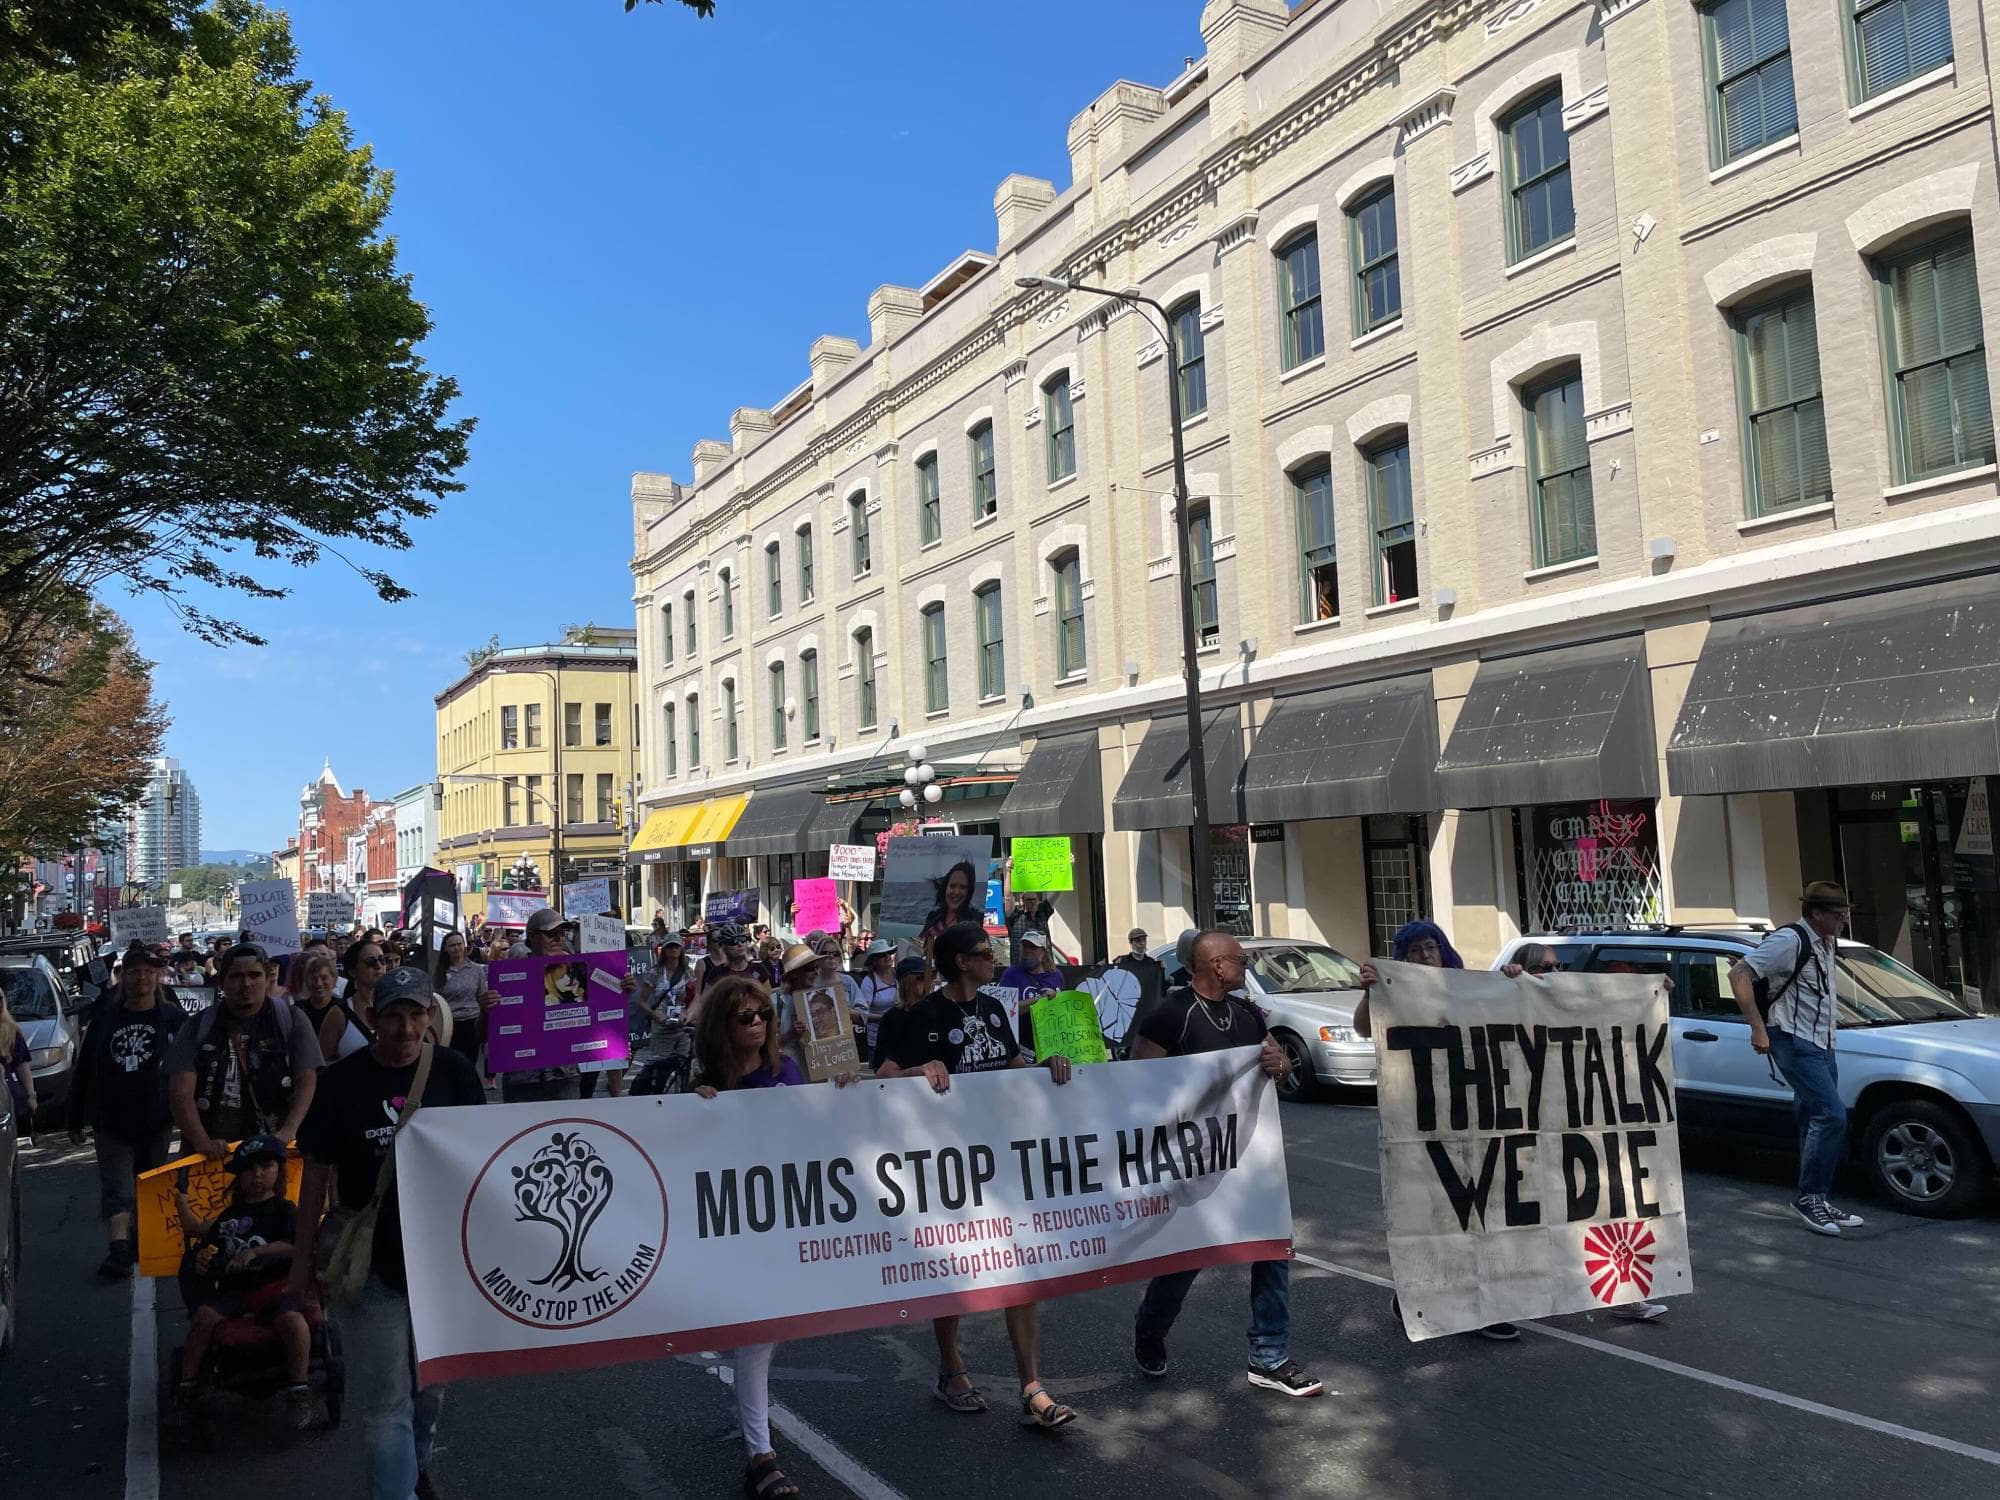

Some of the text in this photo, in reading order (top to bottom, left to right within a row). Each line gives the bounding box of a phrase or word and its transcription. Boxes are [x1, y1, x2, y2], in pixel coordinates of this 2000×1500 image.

[1871, 791, 1886, 801] 614
[1016, 839, 1065, 850] SECURE CARE
[1255, 828, 1281, 838] COMPLEX
[242, 889, 289, 905] EDUCATE
[811, 1042, 833, 1057] They
[1386, 1022, 1675, 1131] THEY TALK
[365, 1126, 396, 1139] EXPE
[695, 1113, 1238, 1239] MOMS STOP THE HARM
[1425, 1130, 1660, 1232] WE DIE
[798, 1231, 893, 1263] EDUCATING
[914, 1216, 1013, 1248] ADVOCATING
[1033, 1203, 1111, 1233] REDUCING
[1115, 1194, 1170, 1221] STIGMA
[881, 1235, 1106, 1286] momsstoptheharm.com
[482, 1243, 657, 1321] MOMS STOP THE HARM
